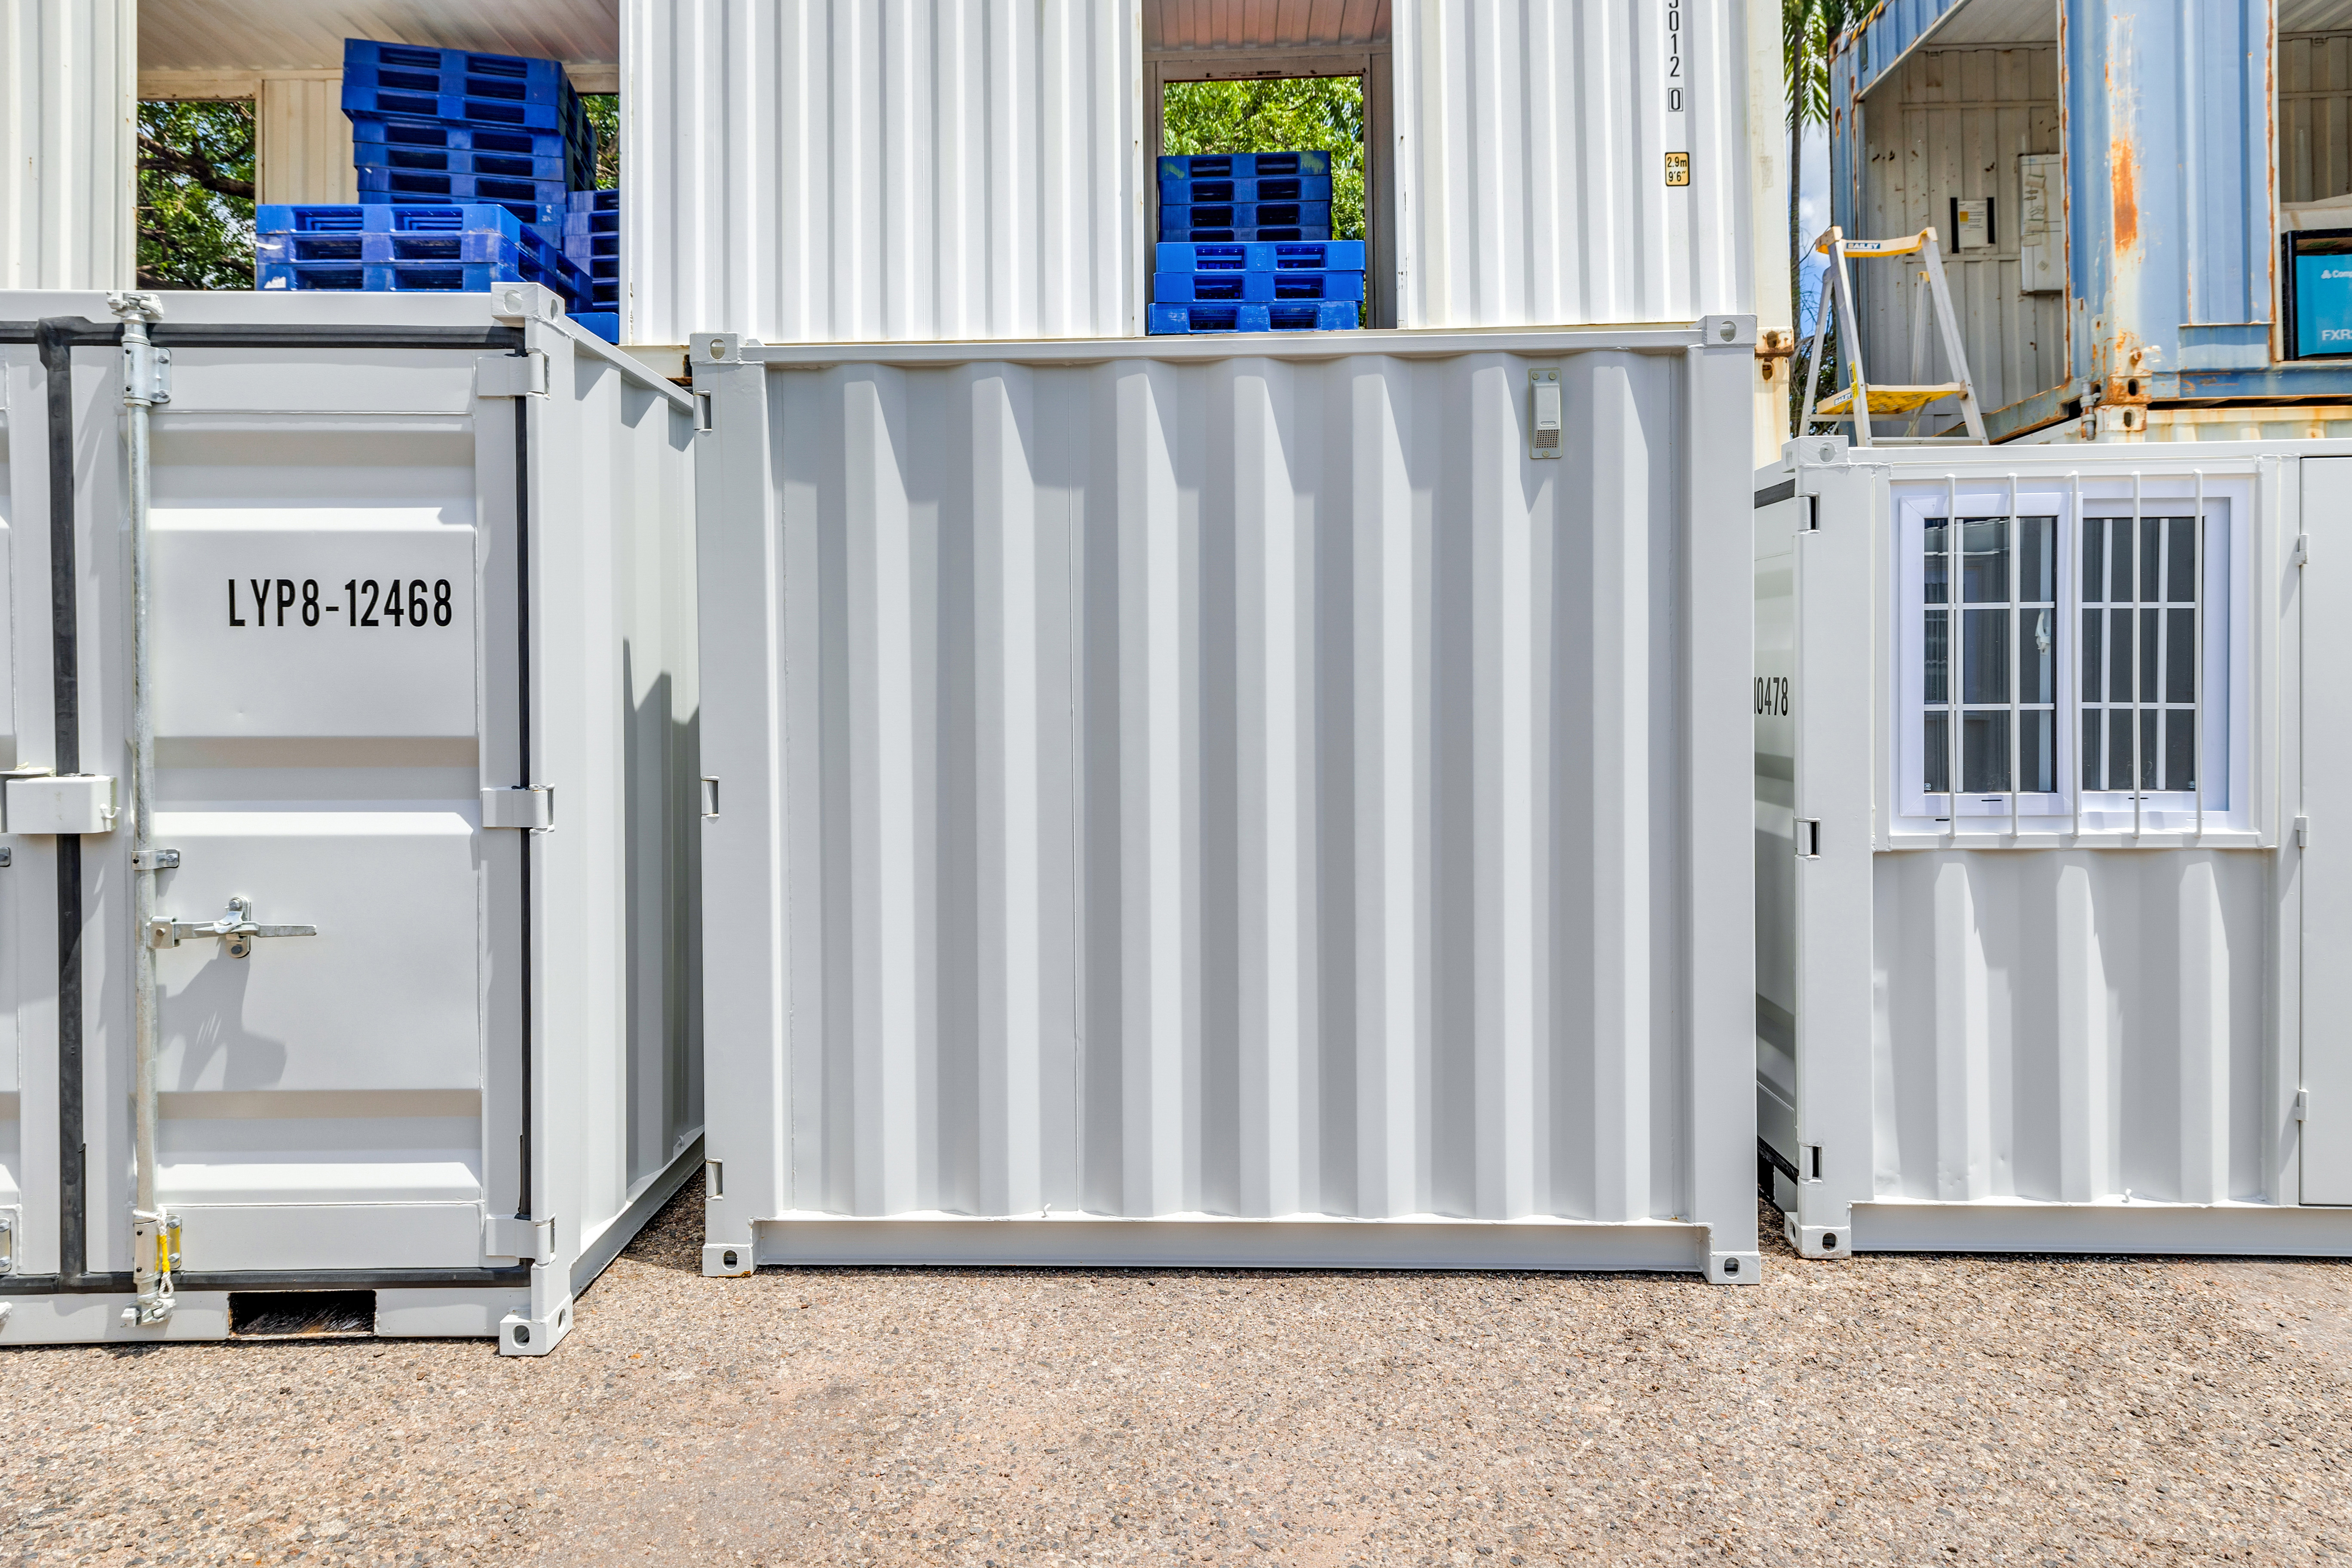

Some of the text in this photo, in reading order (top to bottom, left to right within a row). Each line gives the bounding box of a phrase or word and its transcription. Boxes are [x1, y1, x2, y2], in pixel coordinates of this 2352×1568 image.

[1667, 156, 1687, 168] 2.9m
[2321, 329, 2352, 340] FXR
[1835, 392, 1852, 405] BAILEY
[228, 579, 453, 627] LYP8-12468
